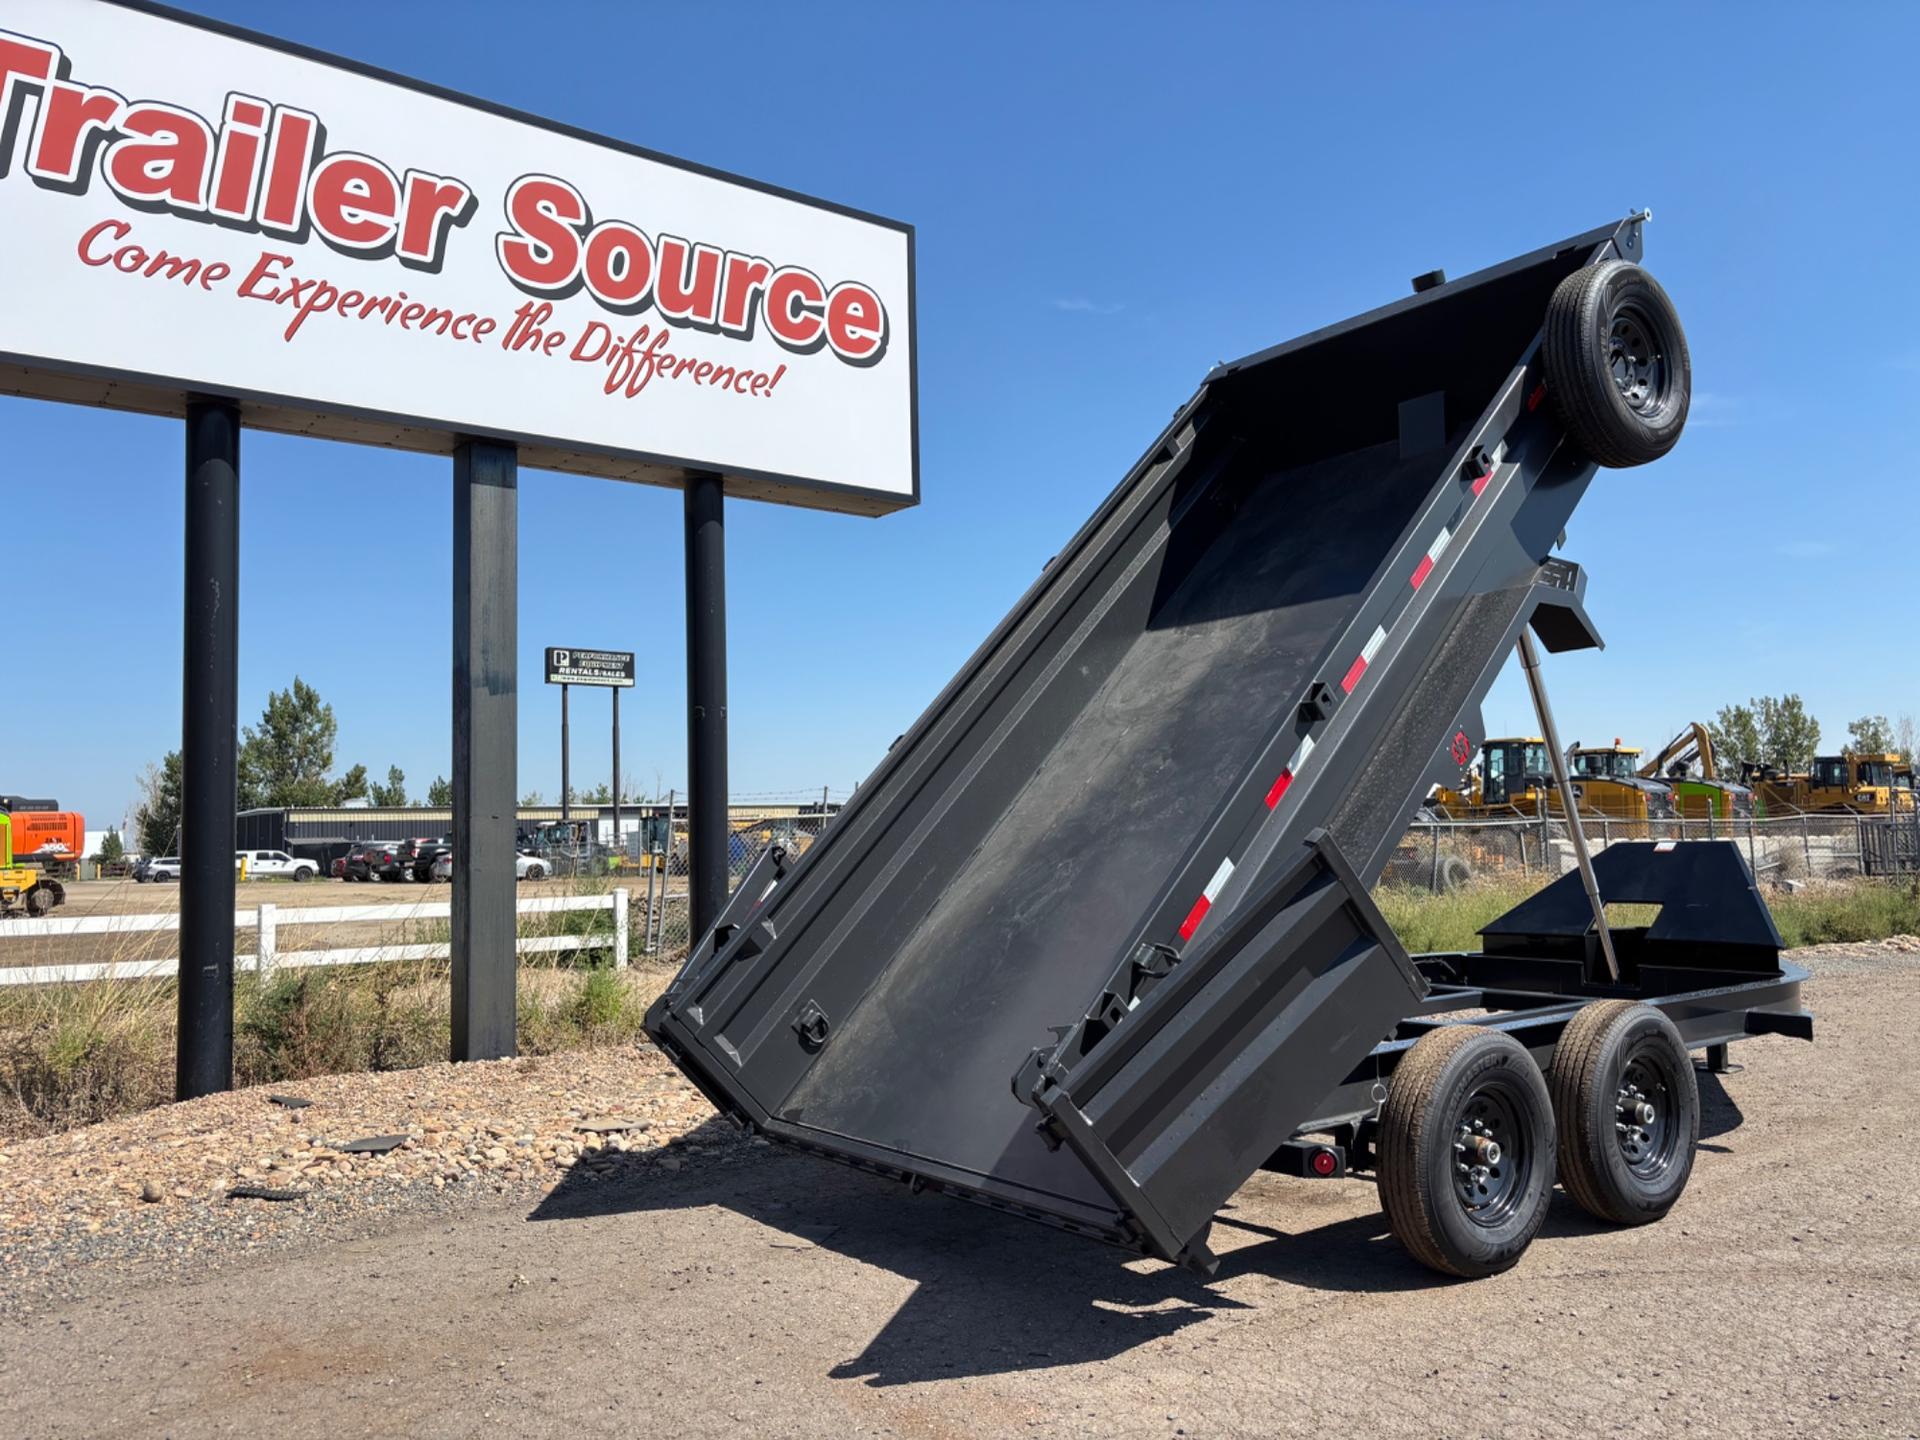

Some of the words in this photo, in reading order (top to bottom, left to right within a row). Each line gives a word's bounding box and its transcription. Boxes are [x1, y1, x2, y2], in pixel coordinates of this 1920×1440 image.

[77, 218, 231, 291] Come
[237, 251, 497, 342] Experience
[501, 300, 566, 356] the
[570, 320, 787, 399] Difference!
[497, 174, 889, 367] Source
